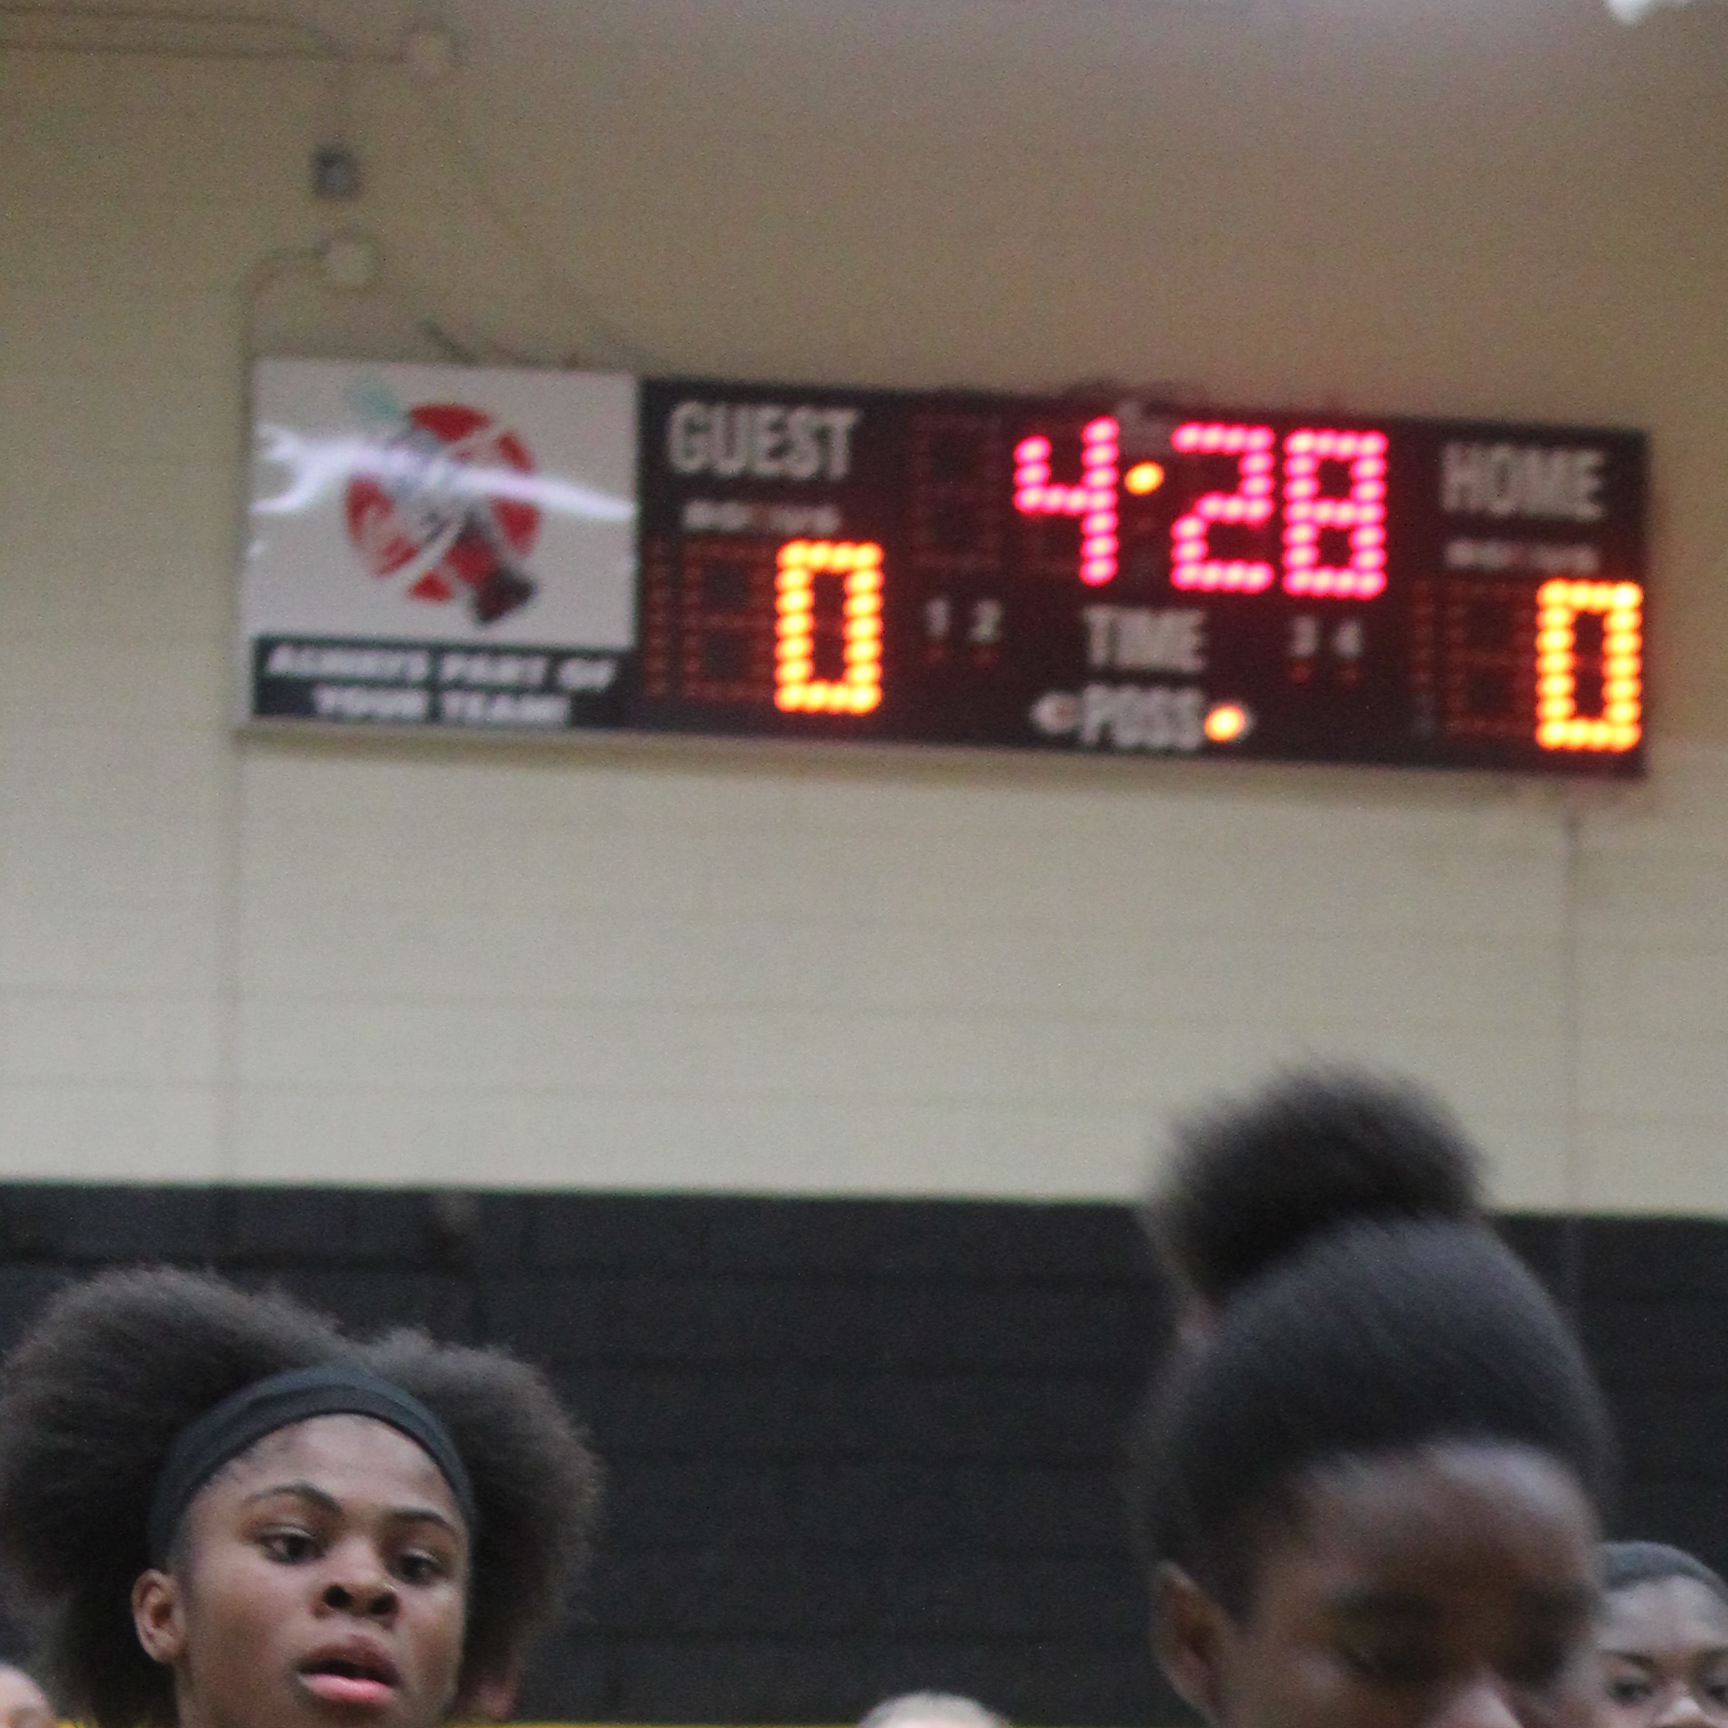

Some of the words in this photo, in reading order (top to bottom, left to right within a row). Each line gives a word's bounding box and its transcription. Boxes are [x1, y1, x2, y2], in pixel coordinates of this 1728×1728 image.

[668, 402, 860, 478] GUEST
[1442, 444, 1604, 520] HOME
[775, 538, 884, 716] 0
[1084, 604, 1206, 670] TIME
[1536, 577, 1643, 753] 0
[440, 652, 546, 687] PART
[1080, 682, 1204, 750] POSS
